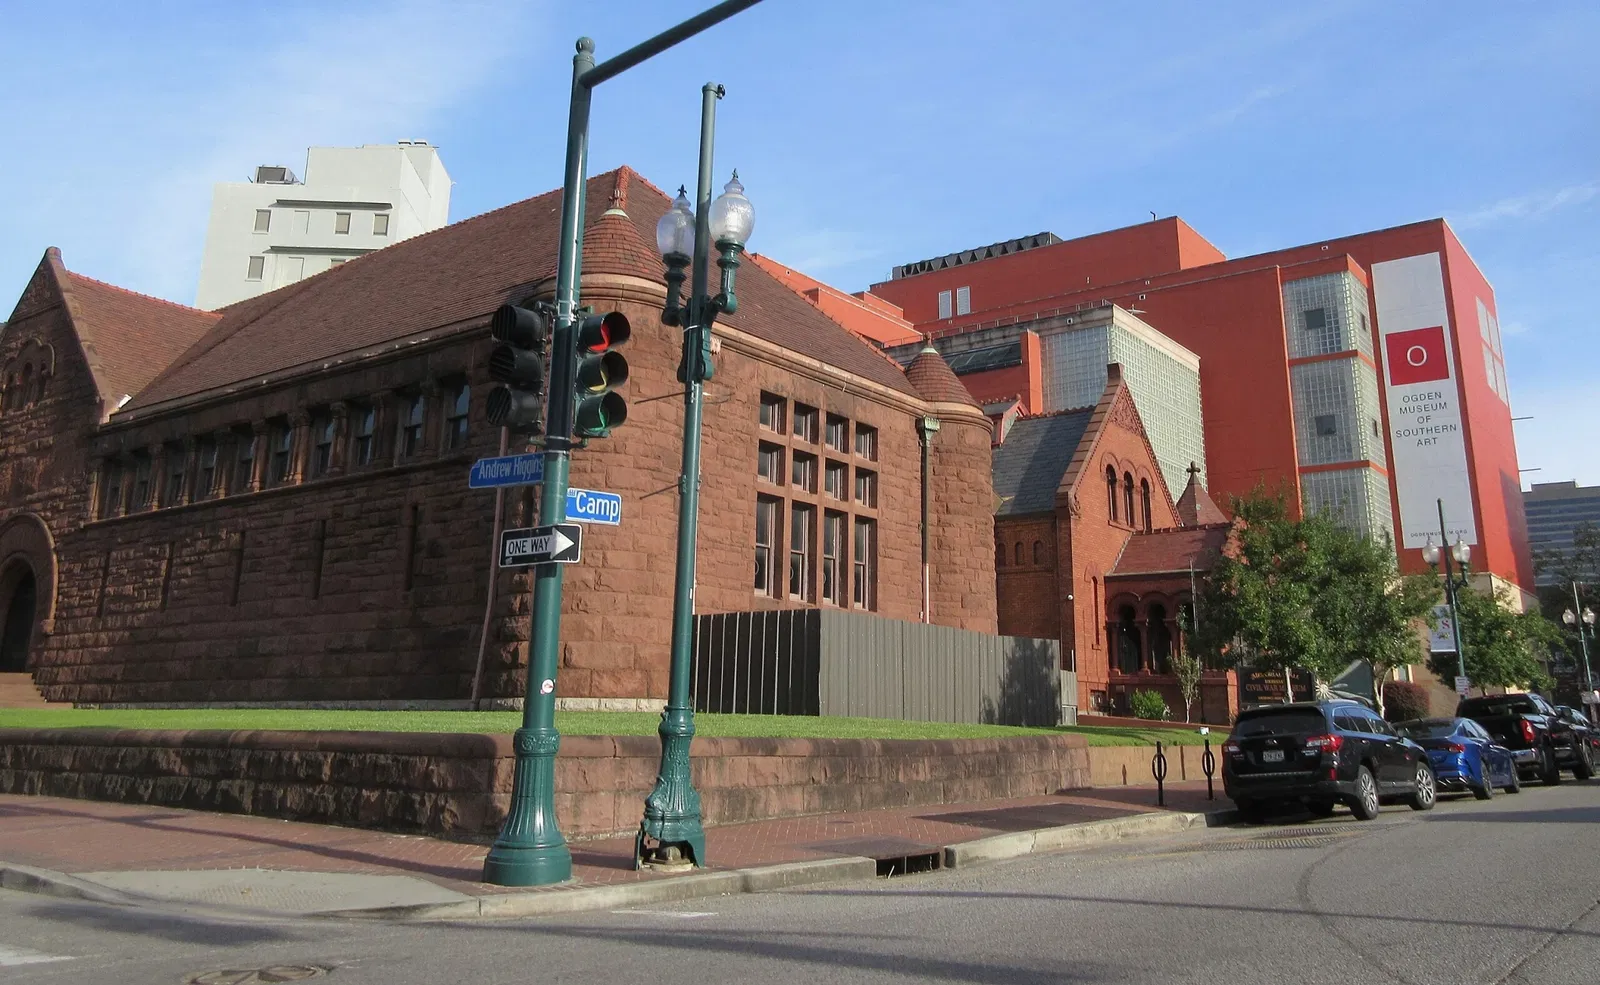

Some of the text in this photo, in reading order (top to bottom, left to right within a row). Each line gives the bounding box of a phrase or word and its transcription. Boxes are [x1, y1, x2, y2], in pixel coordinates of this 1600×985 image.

[1406, 345, 1427, 366] O
[1402, 391, 1442, 403] OGDEN
[1399, 402, 1448, 415] MUSEUM
[1416, 415, 1432, 424] OF
[1395, 424, 1457, 438] SOUTHERN
[1416, 437, 1438, 447] ART
[478, 455, 545, 481] Andrew Higgins
[576, 491, 619, 522] Camp
[508, 537, 550, 555] ONE WAY
[1245, 683, 1263, 692] CIVIL
[1263, 683, 1278, 692] WAR
